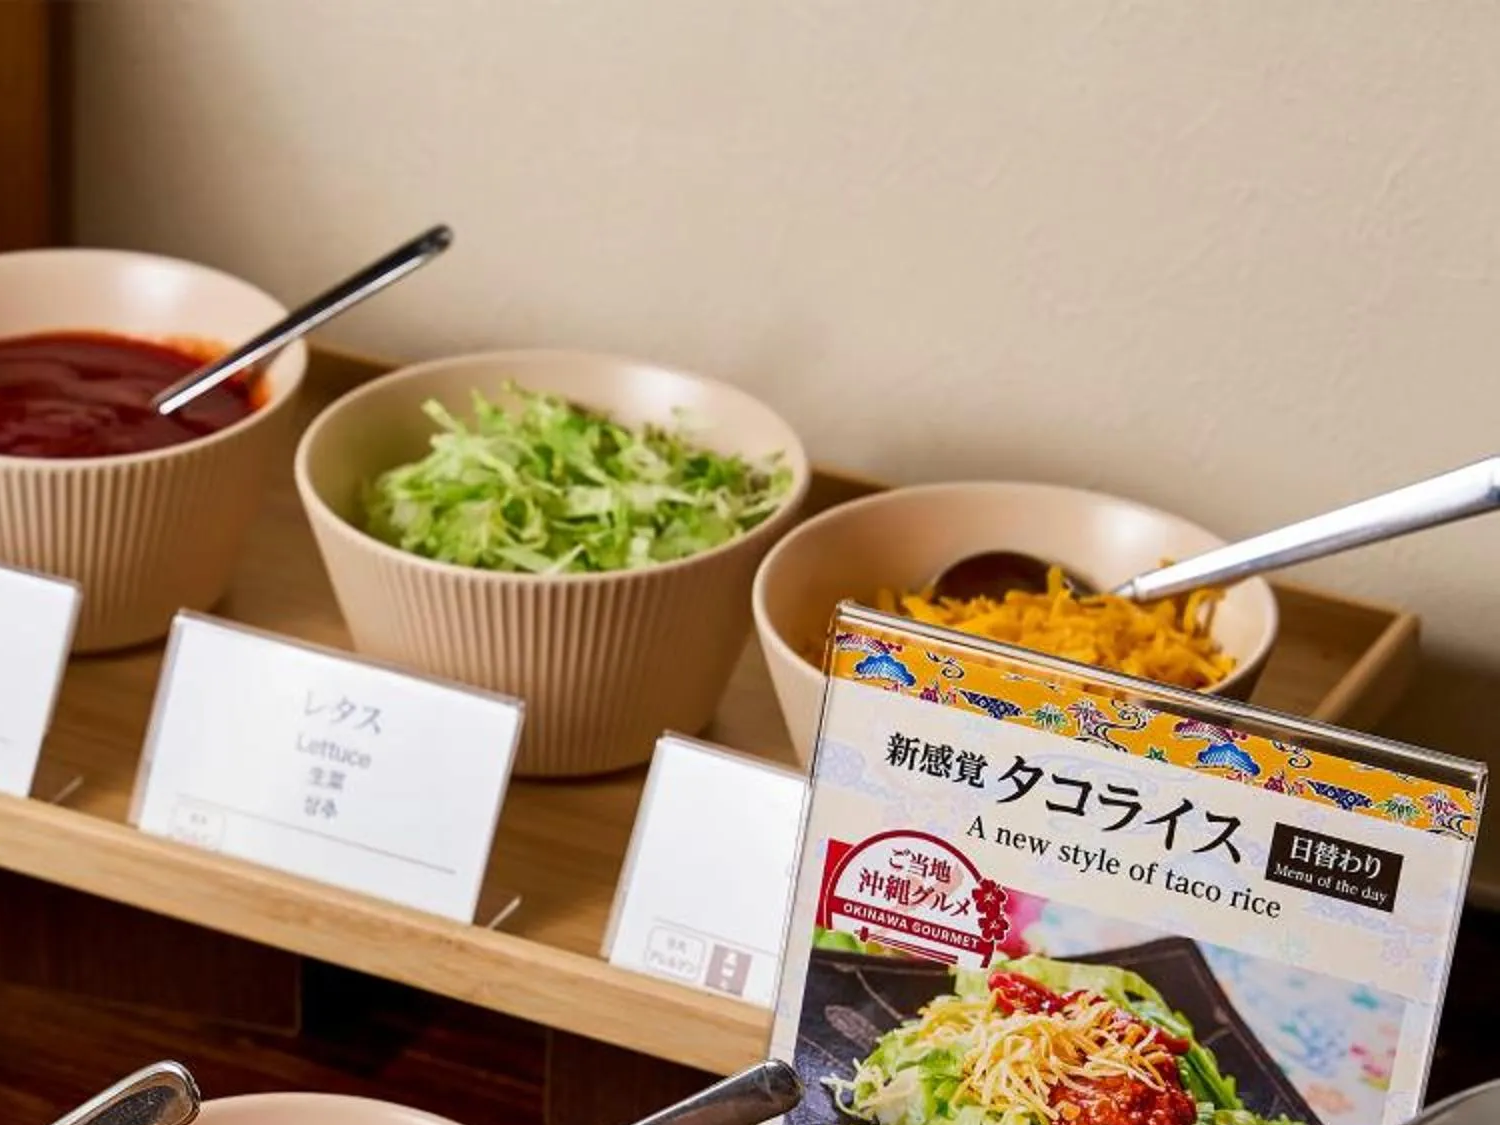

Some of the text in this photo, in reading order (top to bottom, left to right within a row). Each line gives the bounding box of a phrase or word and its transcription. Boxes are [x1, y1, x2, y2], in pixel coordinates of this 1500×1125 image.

[304, 689, 382, 735] レタス
[296, 731, 372, 770] Lettuce
[885, 731, 1245, 865] 新感覚 タコライス
[889, 848, 951, 883] ご当地
[966, 814, 1282, 921] A new style of taco rice
[1290, 835, 1382, 879] 日替わり
[858, 867, 971, 917] 沖縄グルメ
[1273, 863, 1388, 905] Menu of the day
[843, 902, 980, 950] OKINAWA GOURMET
